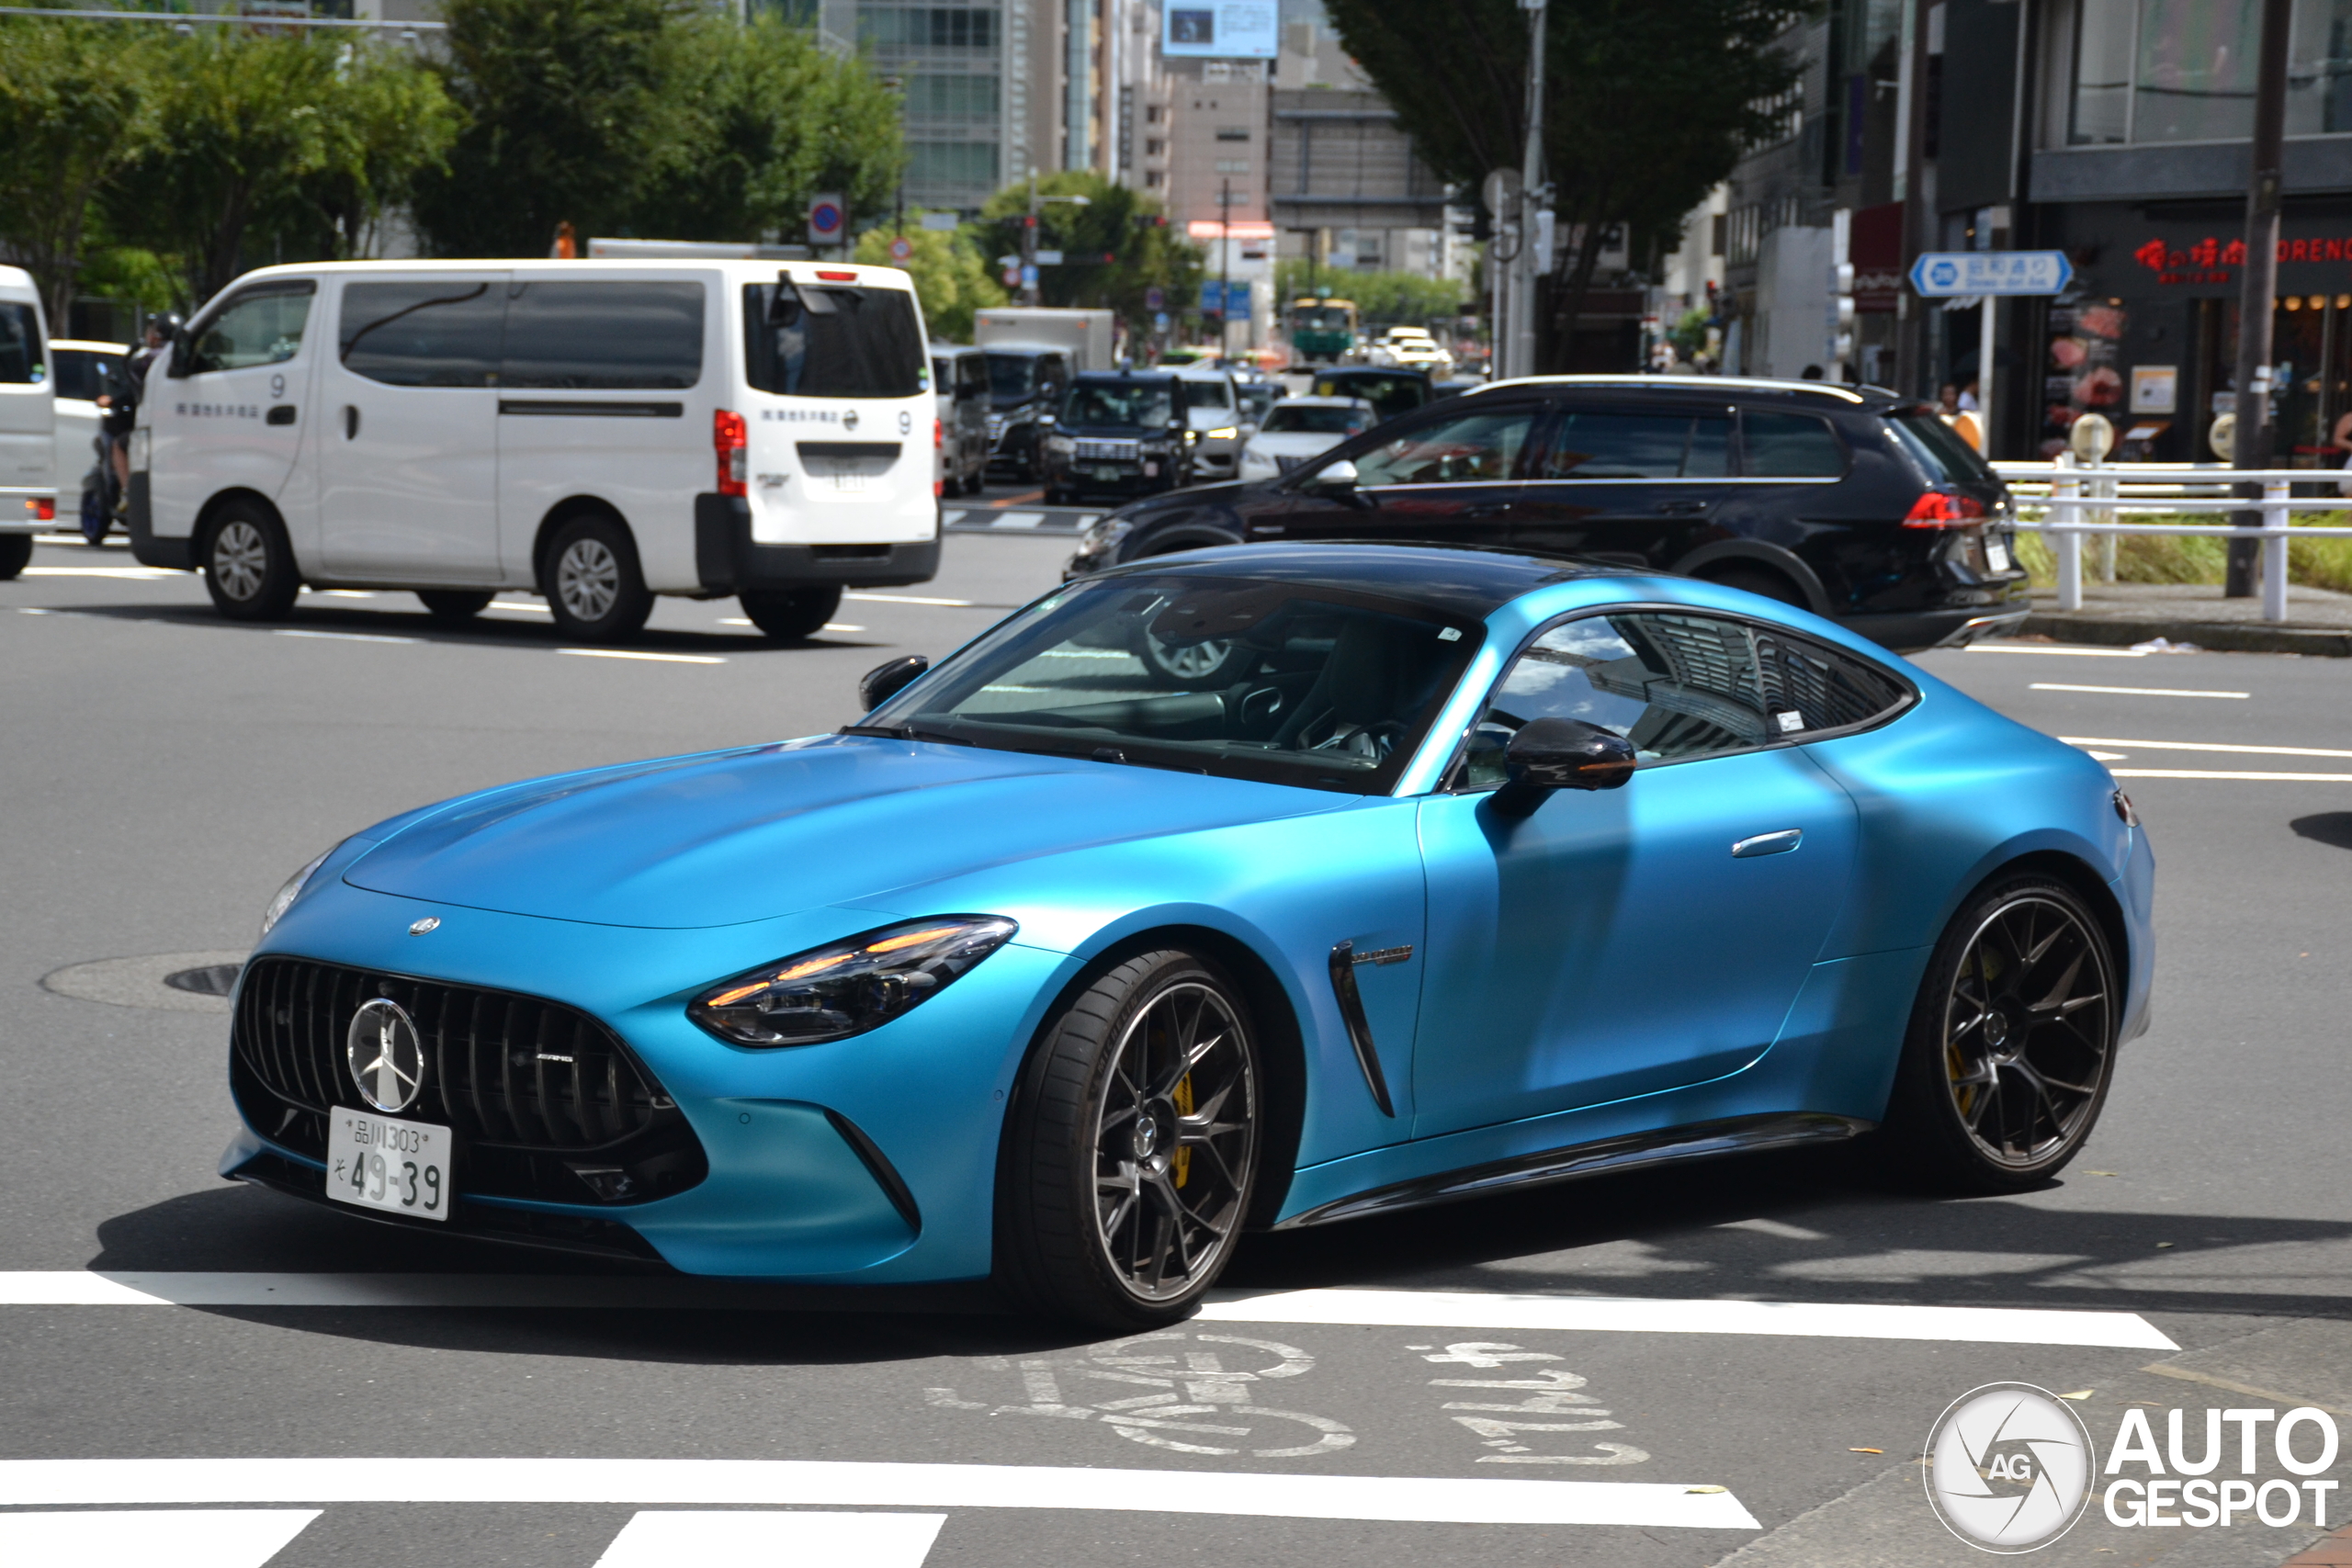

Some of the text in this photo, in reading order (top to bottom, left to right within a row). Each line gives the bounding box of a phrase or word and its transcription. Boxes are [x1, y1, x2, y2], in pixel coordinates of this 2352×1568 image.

[1968, 258, 2047, 274] 昭和通り
[272, 374, 285, 399] 9
[899, 411, 910, 434] 9
[1097, 995, 1138, 1075] MICHELIN
[355, 1120, 419, 1154] 品川 303
[334, 1152, 440, 1211] そ 49-39
